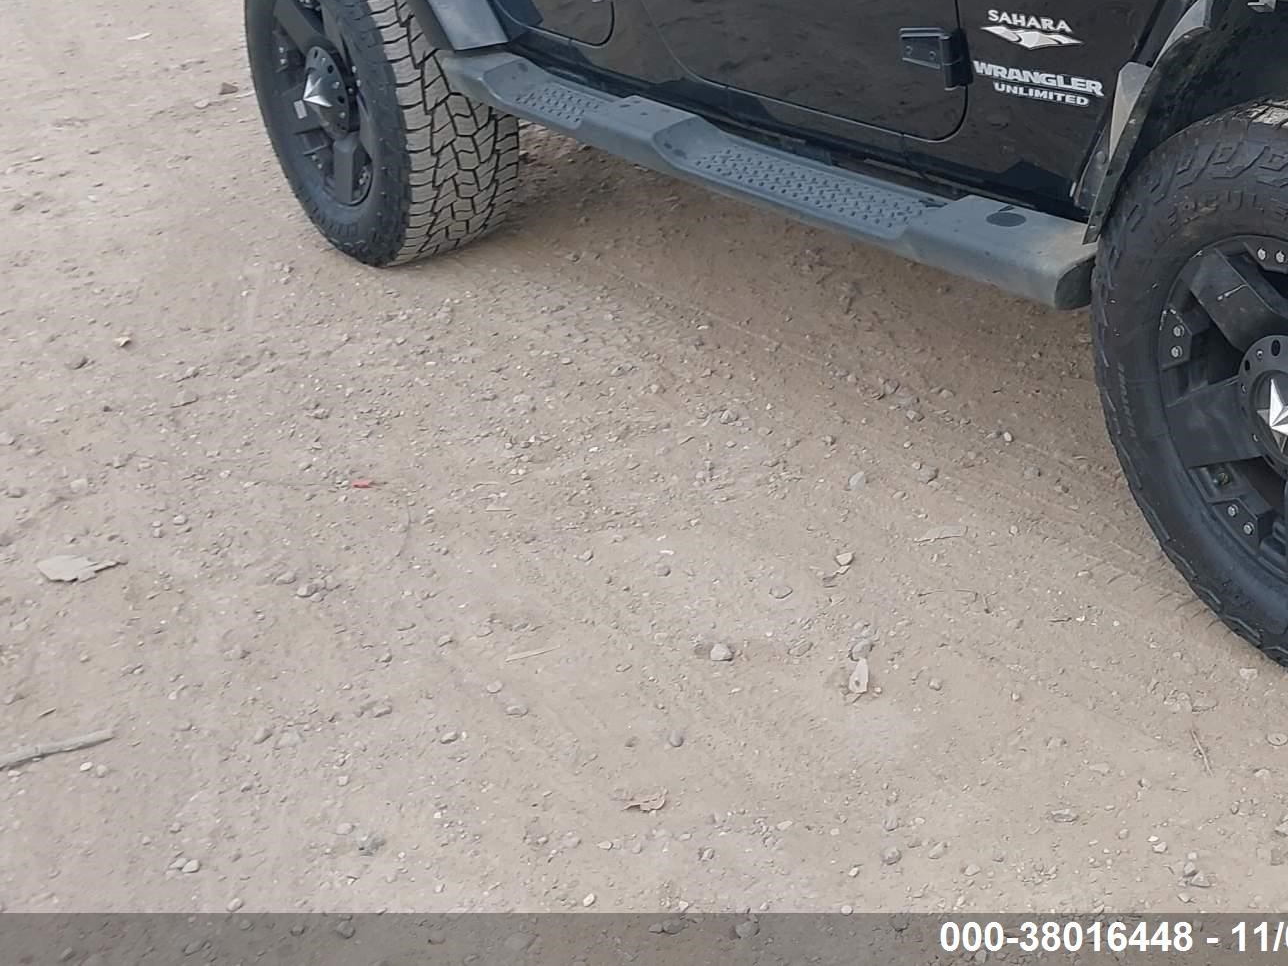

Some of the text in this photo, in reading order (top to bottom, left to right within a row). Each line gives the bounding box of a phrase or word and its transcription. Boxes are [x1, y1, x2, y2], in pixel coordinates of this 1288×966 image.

[987, 9, 1073, 34] SAHARA
[972, 60, 1105, 97] WRANGLER
[994, 82, 1089, 107] UNLIMITED
